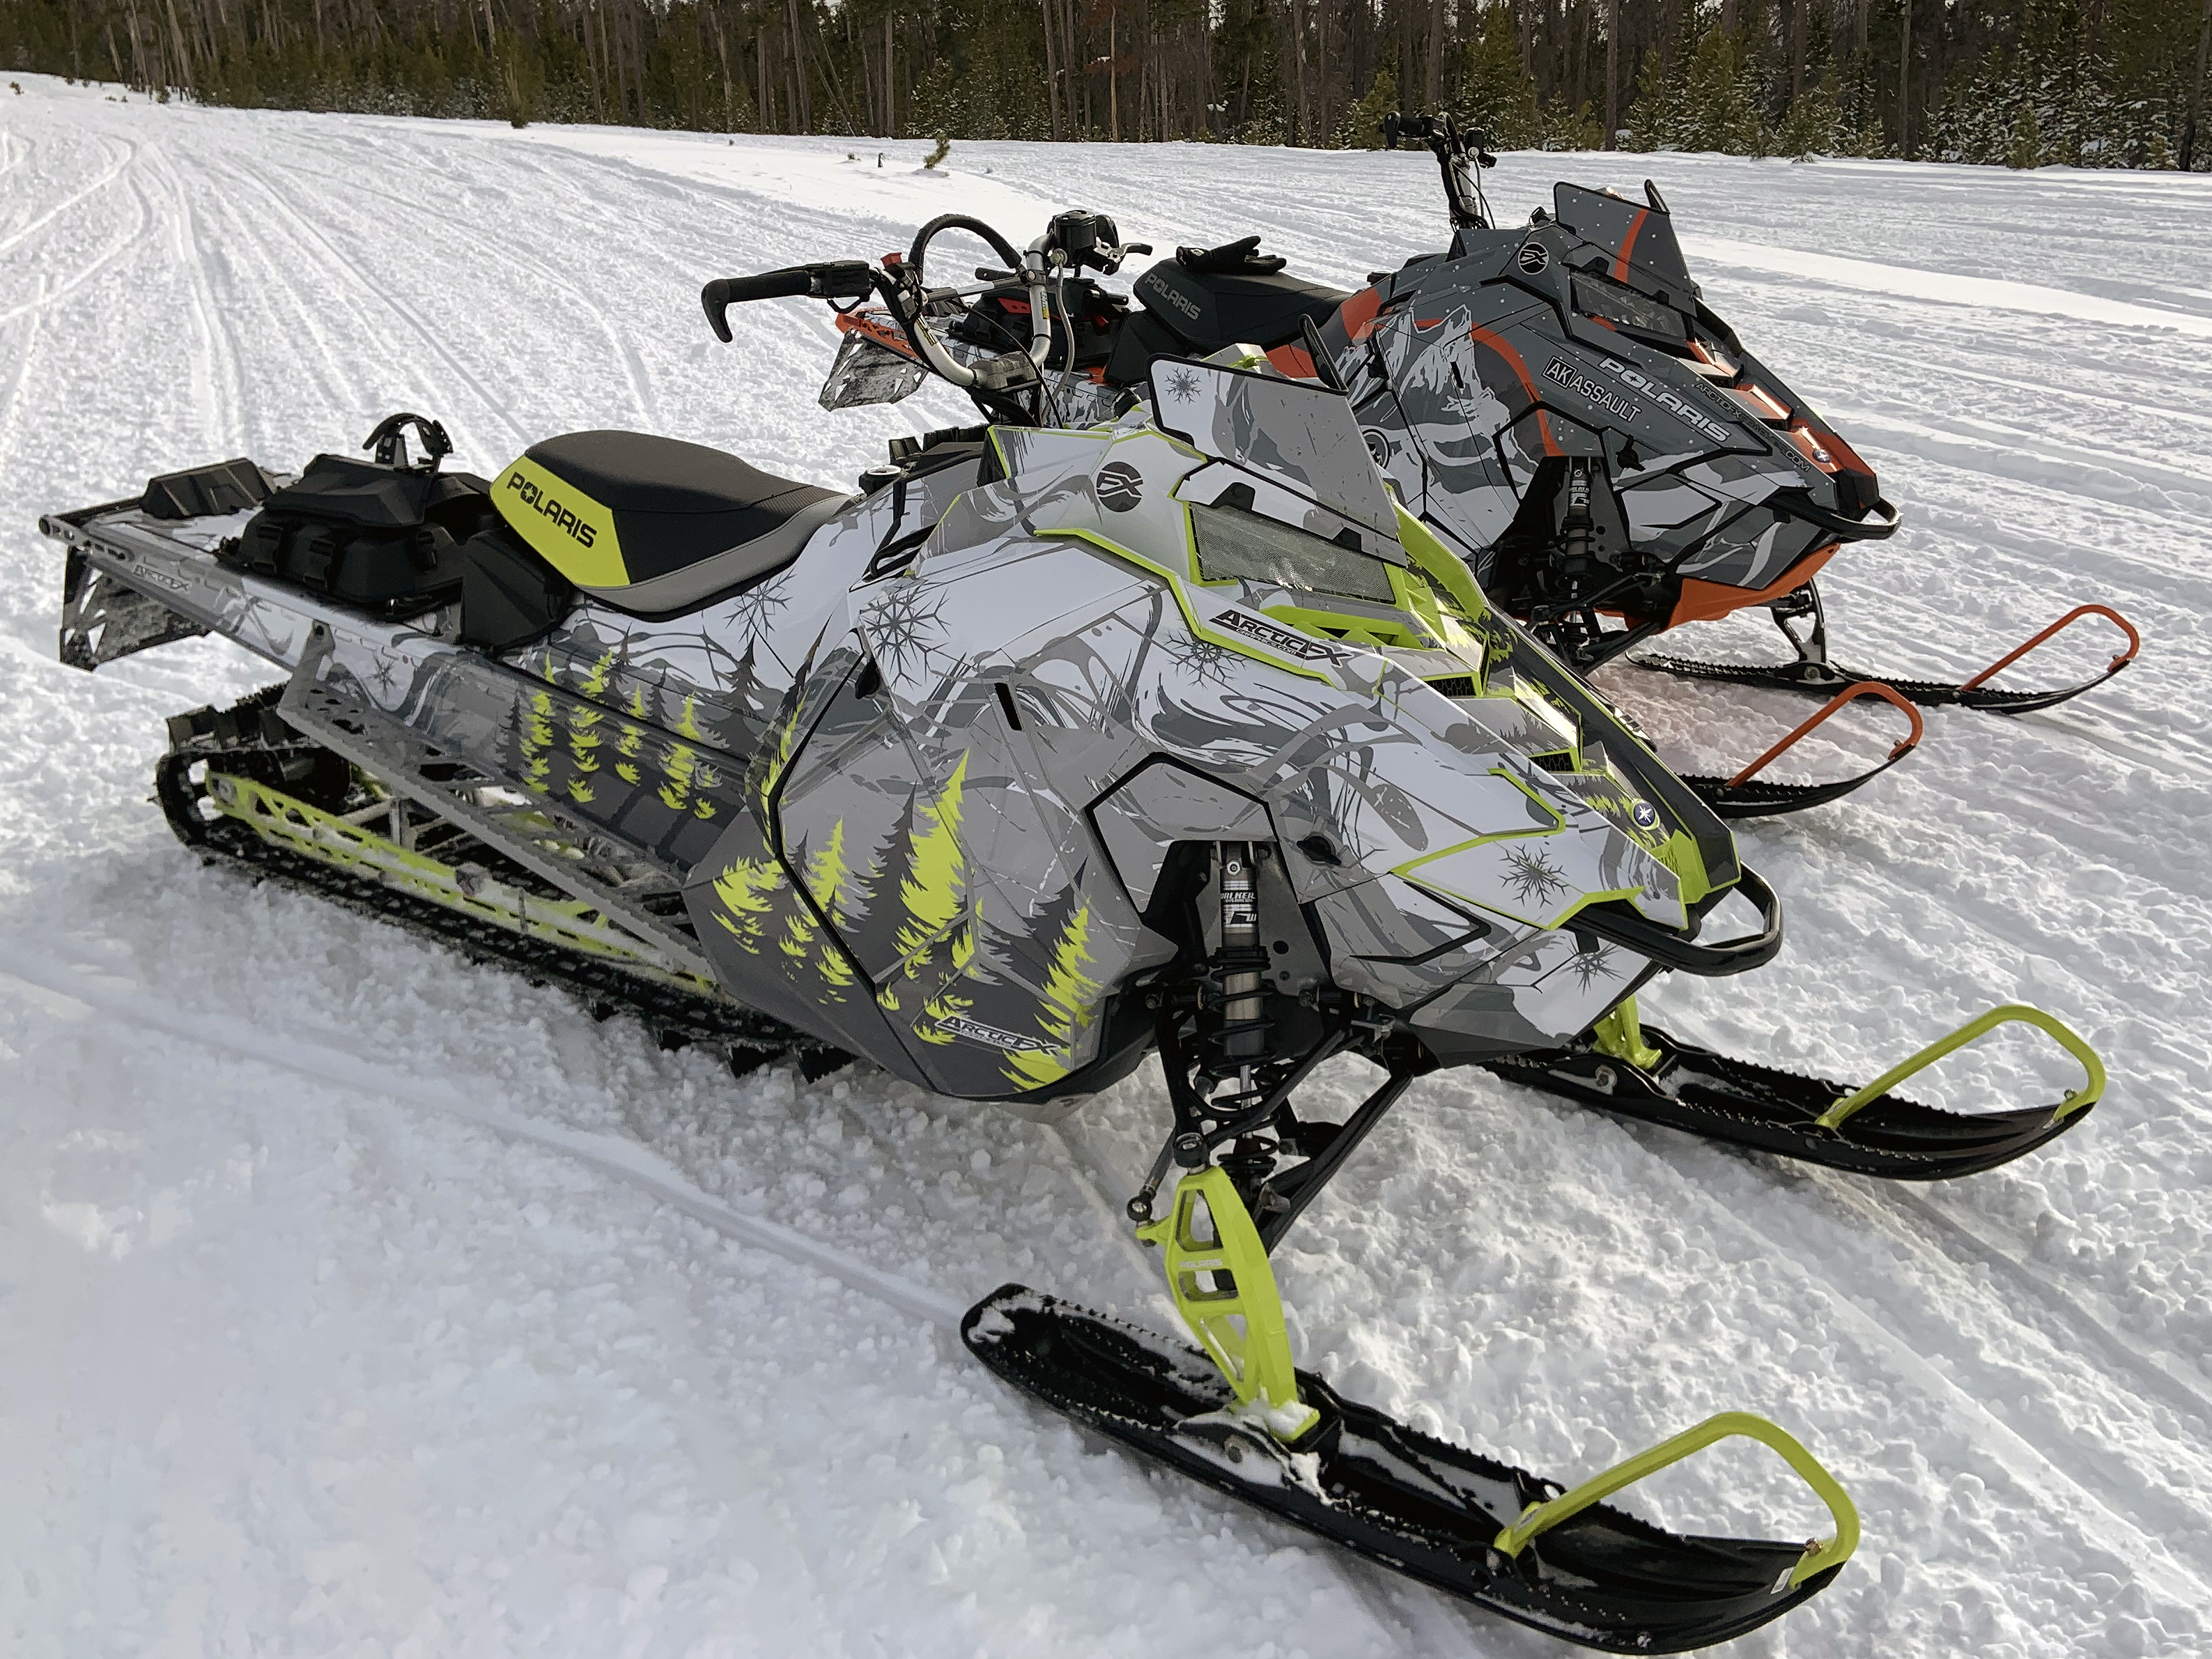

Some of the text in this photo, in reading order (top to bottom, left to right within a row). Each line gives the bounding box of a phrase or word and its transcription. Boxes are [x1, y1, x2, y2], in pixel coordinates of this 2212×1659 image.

[1144, 272, 1202, 320] POLARIS
[1545, 360, 1642, 423] AK ASSAULT
[1600, 357, 1732, 442] POLARIS
[506, 471, 598, 548] POLARIS
